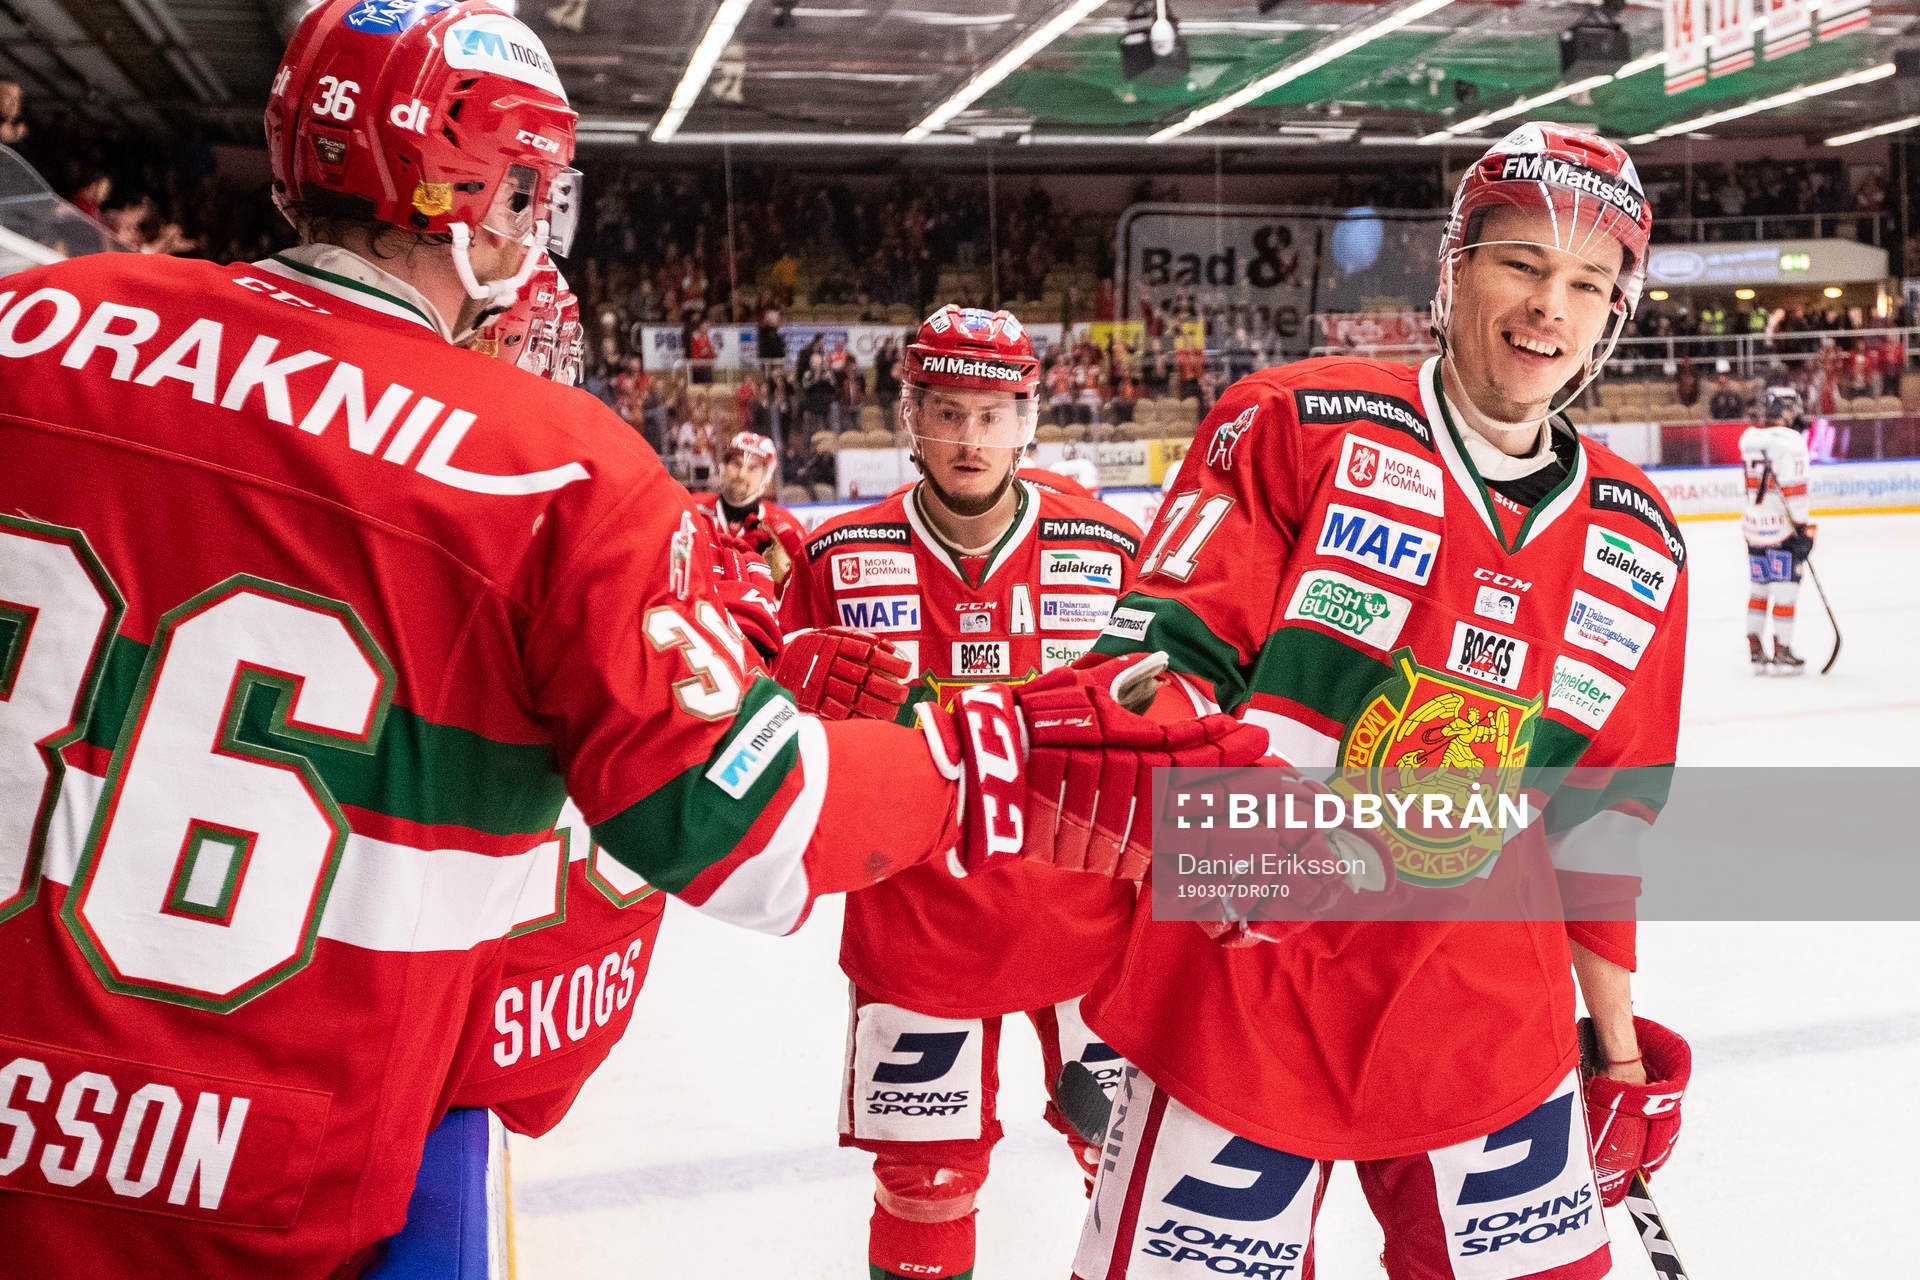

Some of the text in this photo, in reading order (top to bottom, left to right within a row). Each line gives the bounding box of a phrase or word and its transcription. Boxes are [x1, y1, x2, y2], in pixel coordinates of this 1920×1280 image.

[312, 75, 361, 121] 36
[389, 98, 431, 135] dt
[515, 129, 561, 154] CCM
[1502, 157, 1642, 222] FM Mattsson
[1141, 225, 1298, 288] Bad &
[232, 276, 333, 315] CC
[922, 356, 1023, 382] FM Mattsson
[1305, 395, 1430, 441] FM Mattsson
[1383, 457, 1421, 481] MORA
[1382, 472, 1437, 500] KOMMUN
[1599, 484, 1632, 506] FM
[1493, 491, 1523, 516] SHL
[810, 527, 907, 556] FM Mattsson
[1043, 521, 1135, 554] FM Mattsson
[864, 557, 896, 568] MORA
[864, 566, 911, 576] KOMMUN
[1050, 561, 1113, 576] dalakraft
[1597, 546, 1664, 590] dalakraft
[1309, 579, 1364, 609] CASH
[1473, 567, 1533, 592] CCM
[955, 601, 998, 611] CCM
[1009, 583, 1036, 635] A
[1299, 598, 1373, 633] BUDDY
[1457, 664, 1507, 684] GRUS AB
[1346, 708, 1388, 779] MORA
[493, 938, 642, 1068] SKOGS
[866, 1090, 969, 1103] JOHNS
[866, 1104, 969, 1116] SPORT
[1454, 1183, 1592, 1236] JOHNS
[1145, 1219, 1302, 1261] JOHNS
[1459, 1204, 1593, 1257] SPORT
[899, 1262, 943, 1275] CCM
[1141, 1239, 1294, 1280] SPORT
